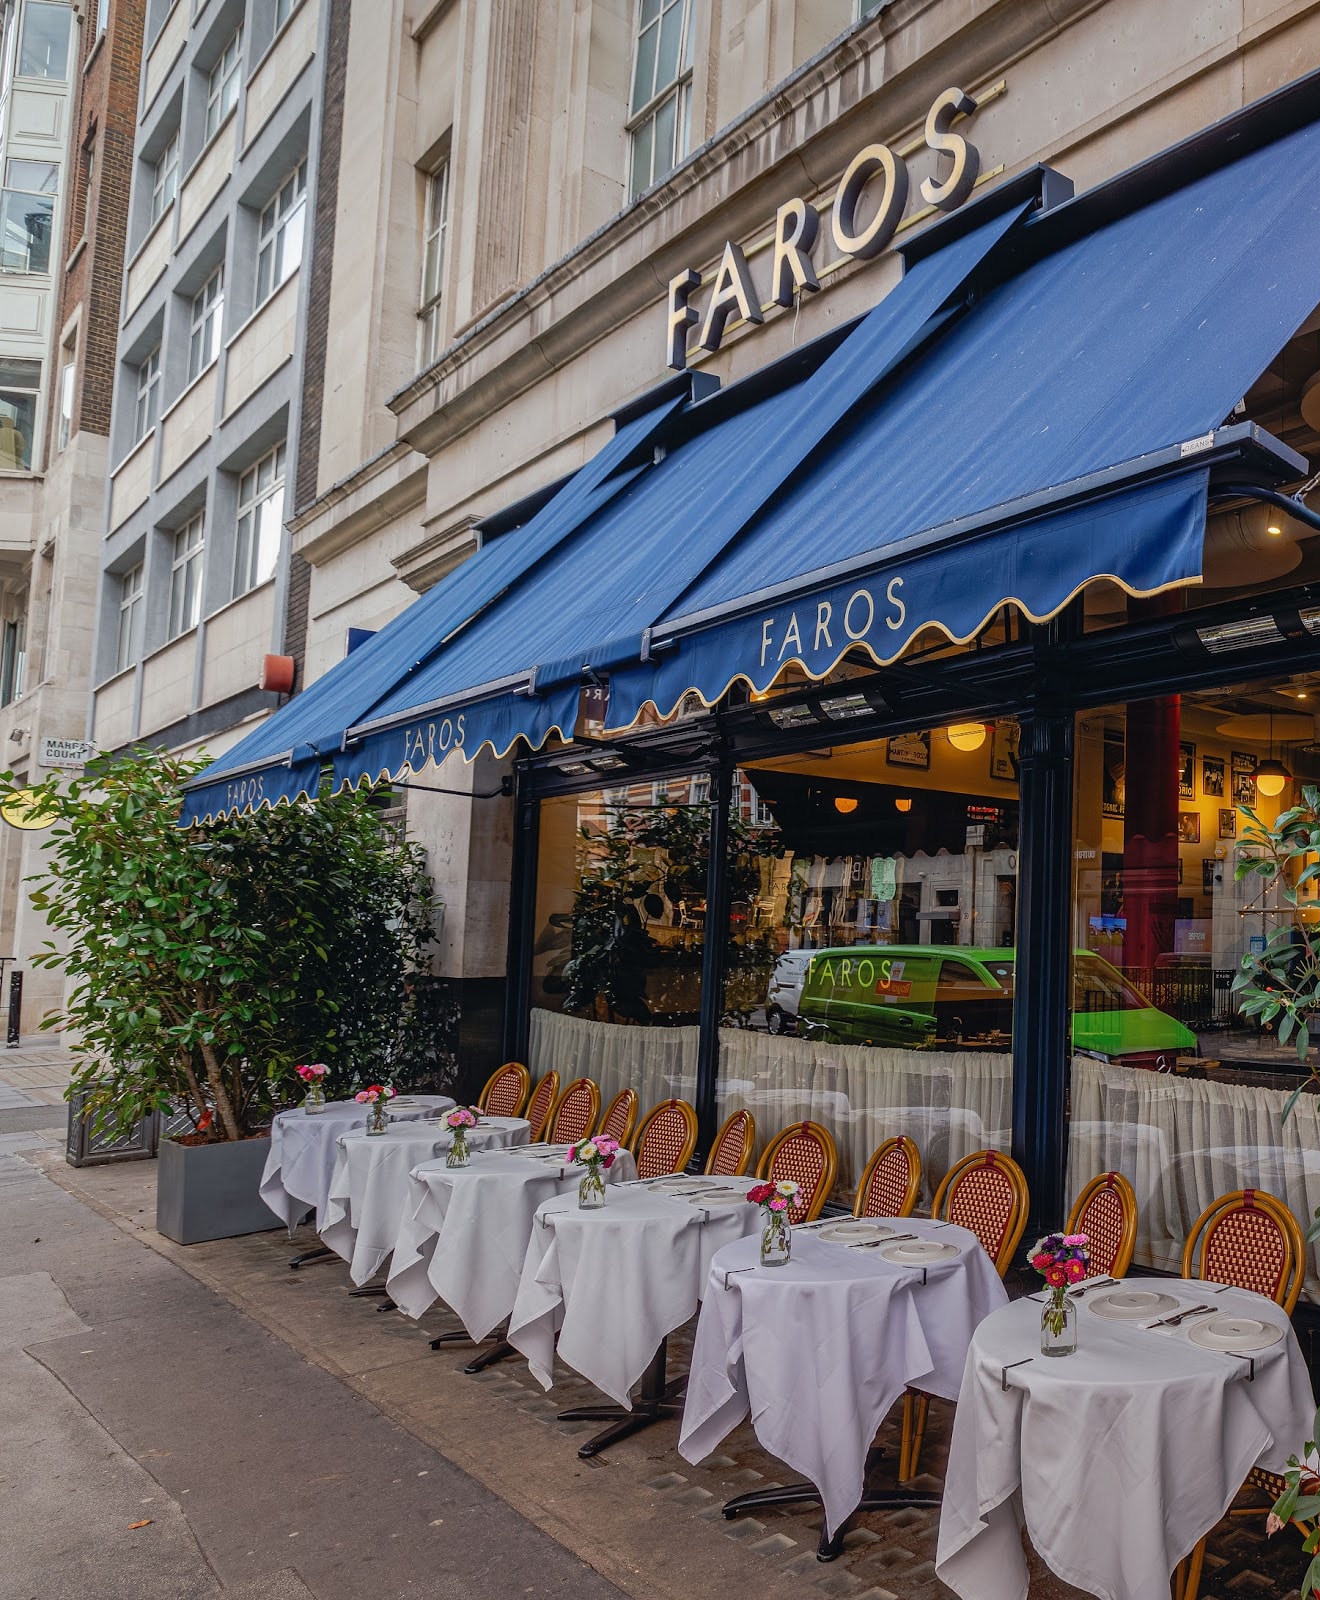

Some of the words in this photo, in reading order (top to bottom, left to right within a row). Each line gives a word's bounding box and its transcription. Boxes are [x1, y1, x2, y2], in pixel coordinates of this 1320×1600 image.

[667, 86, 980, 371] FAROS
[760, 576, 906, 667] FAROS
[404, 714, 466, 761] FAROS
[227, 775, 264, 807] FAROS
[808, 957, 892, 989] FAROS
